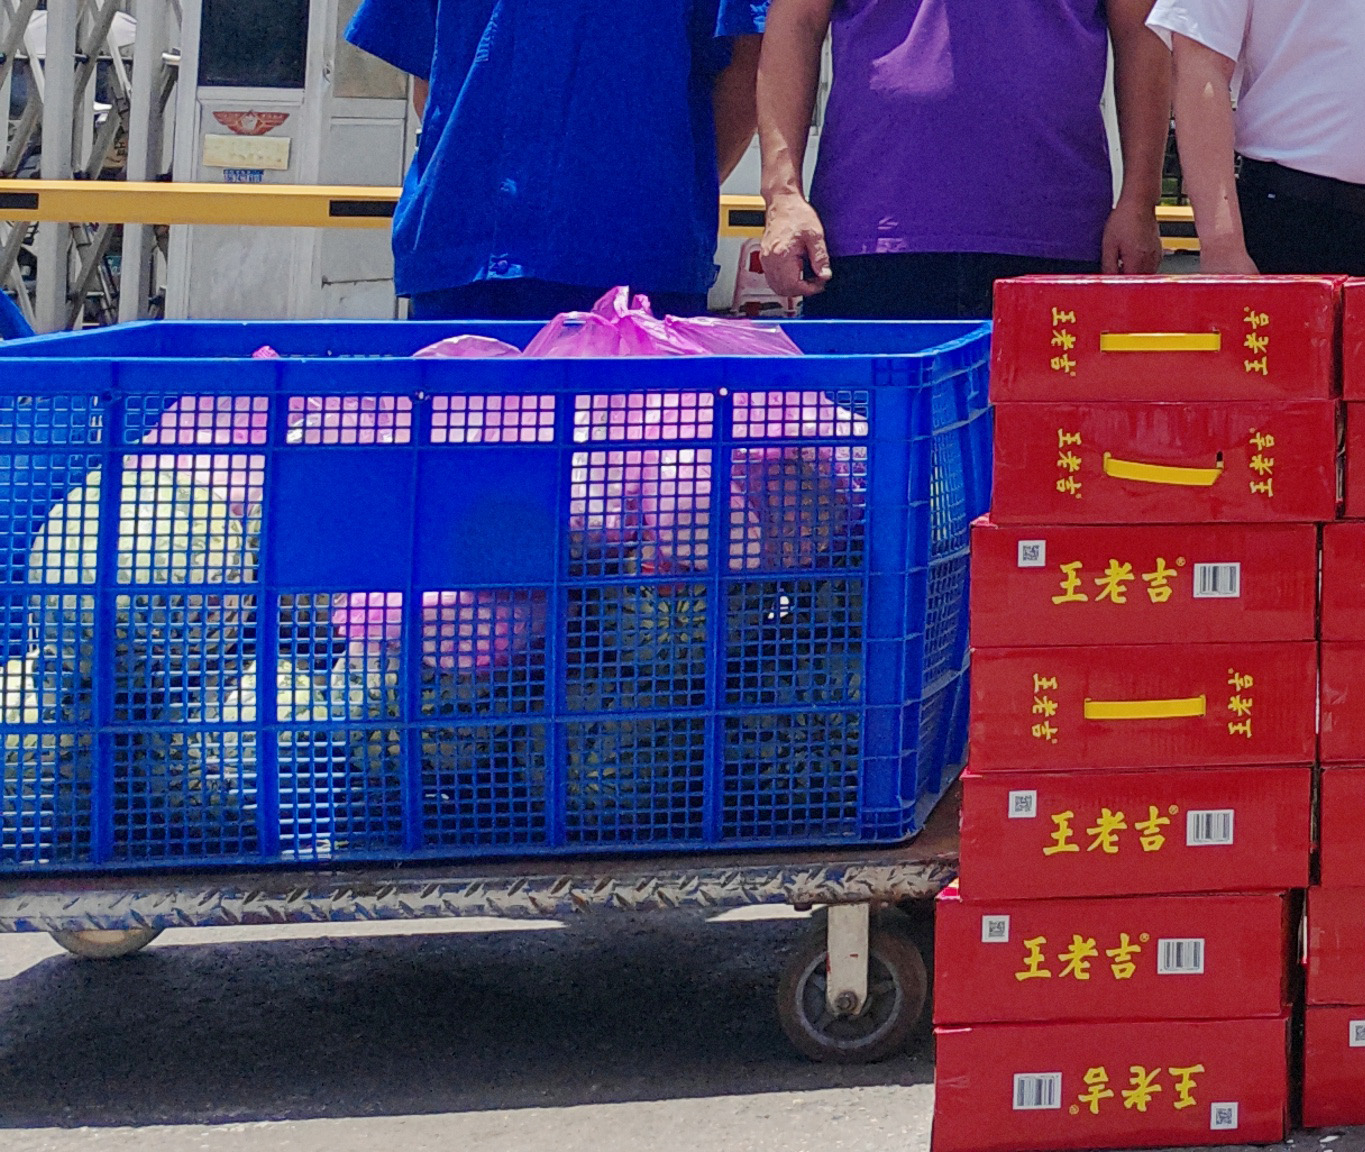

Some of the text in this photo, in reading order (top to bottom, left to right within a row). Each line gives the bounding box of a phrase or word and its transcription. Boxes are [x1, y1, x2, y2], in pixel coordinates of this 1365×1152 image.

[1050, 309, 1077, 372] 王老吉
[1244, 312, 1270, 374] 王老吉
[1055, 432, 1082, 494] 王老吉
[1248, 434, 1275, 496] 王老吉
[1051, 556, 1177, 606] 王老吉
[1030, 674, 1058, 738] 王老吉
[1227, 672, 1255, 736] 王老吉
[1043, 804, 1178, 856] 王老吉
[1014, 932, 1150, 982] 王老吉
[1070, 1064, 1202, 1115] 王老吉
